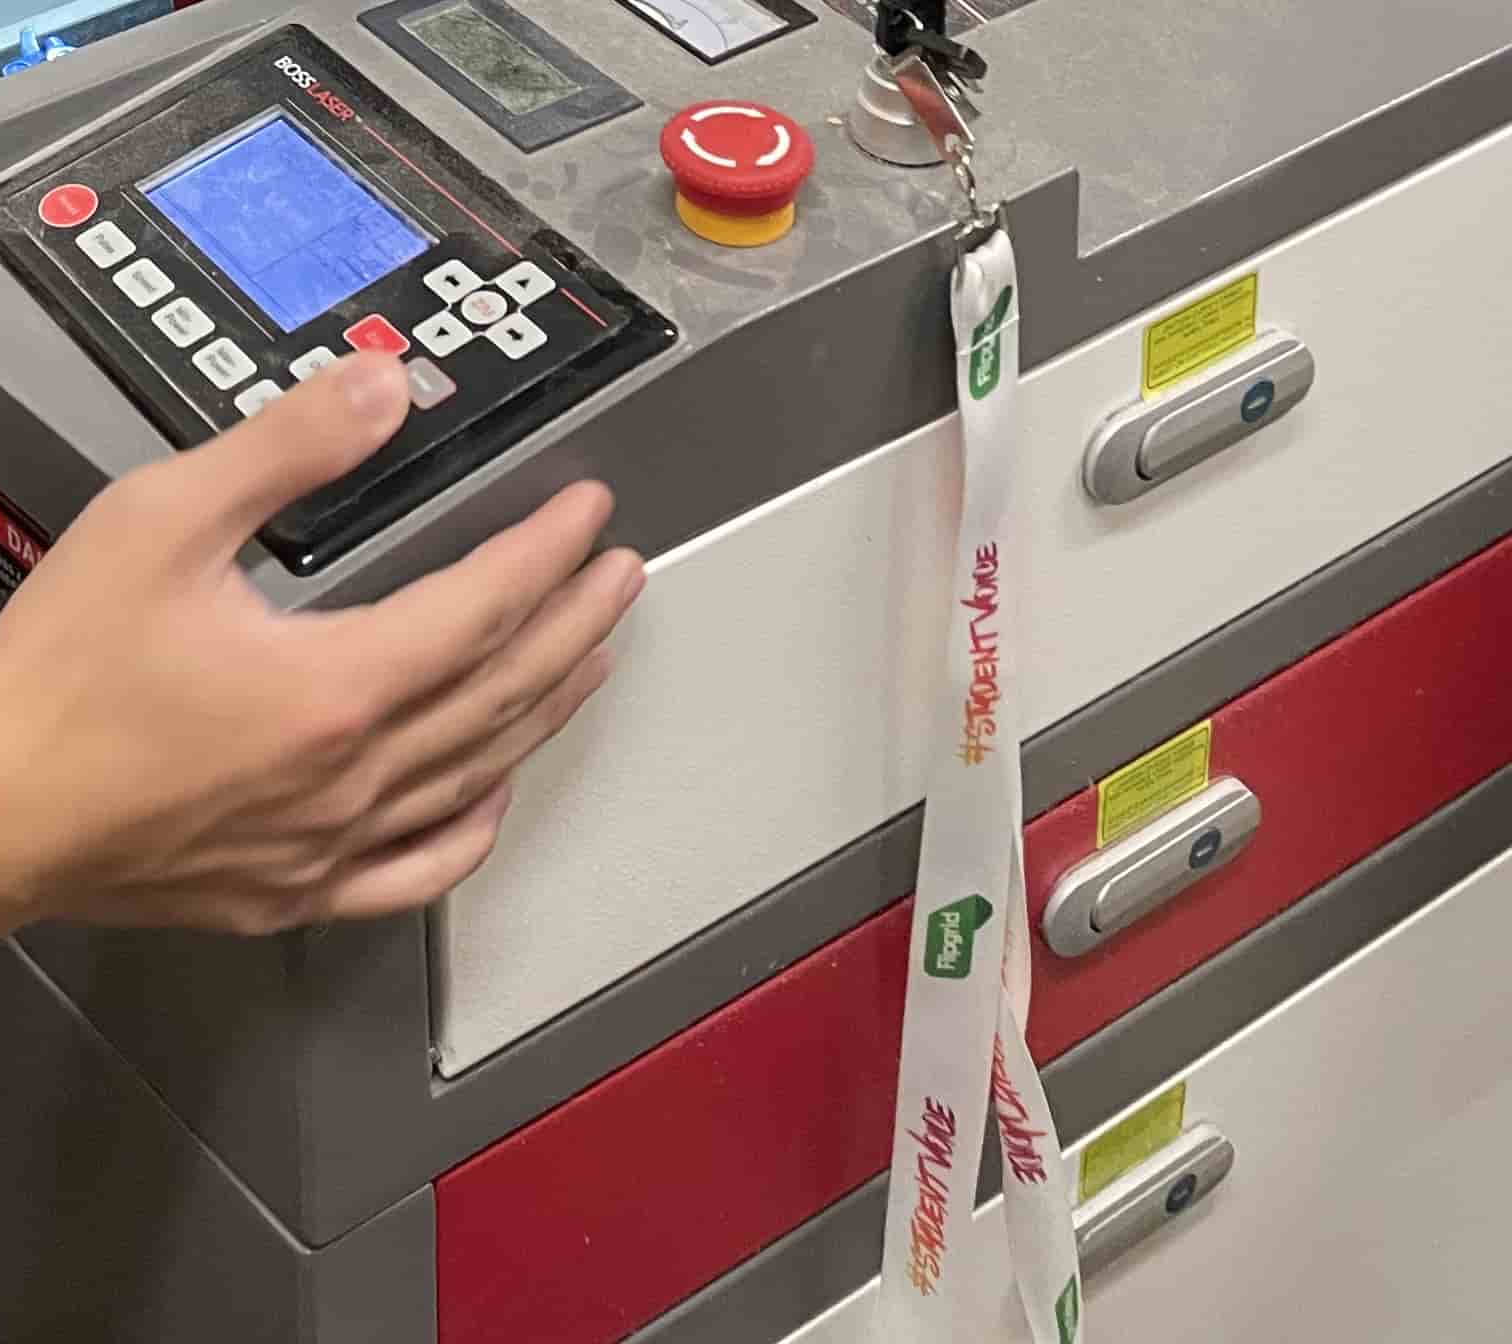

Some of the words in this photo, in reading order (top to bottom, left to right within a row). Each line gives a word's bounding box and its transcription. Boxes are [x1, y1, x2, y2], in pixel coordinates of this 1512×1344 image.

[274, 55, 315, 91] BOSS
[307, 81, 354, 123] LASER
[936, 909, 963, 972] Flipgrid
